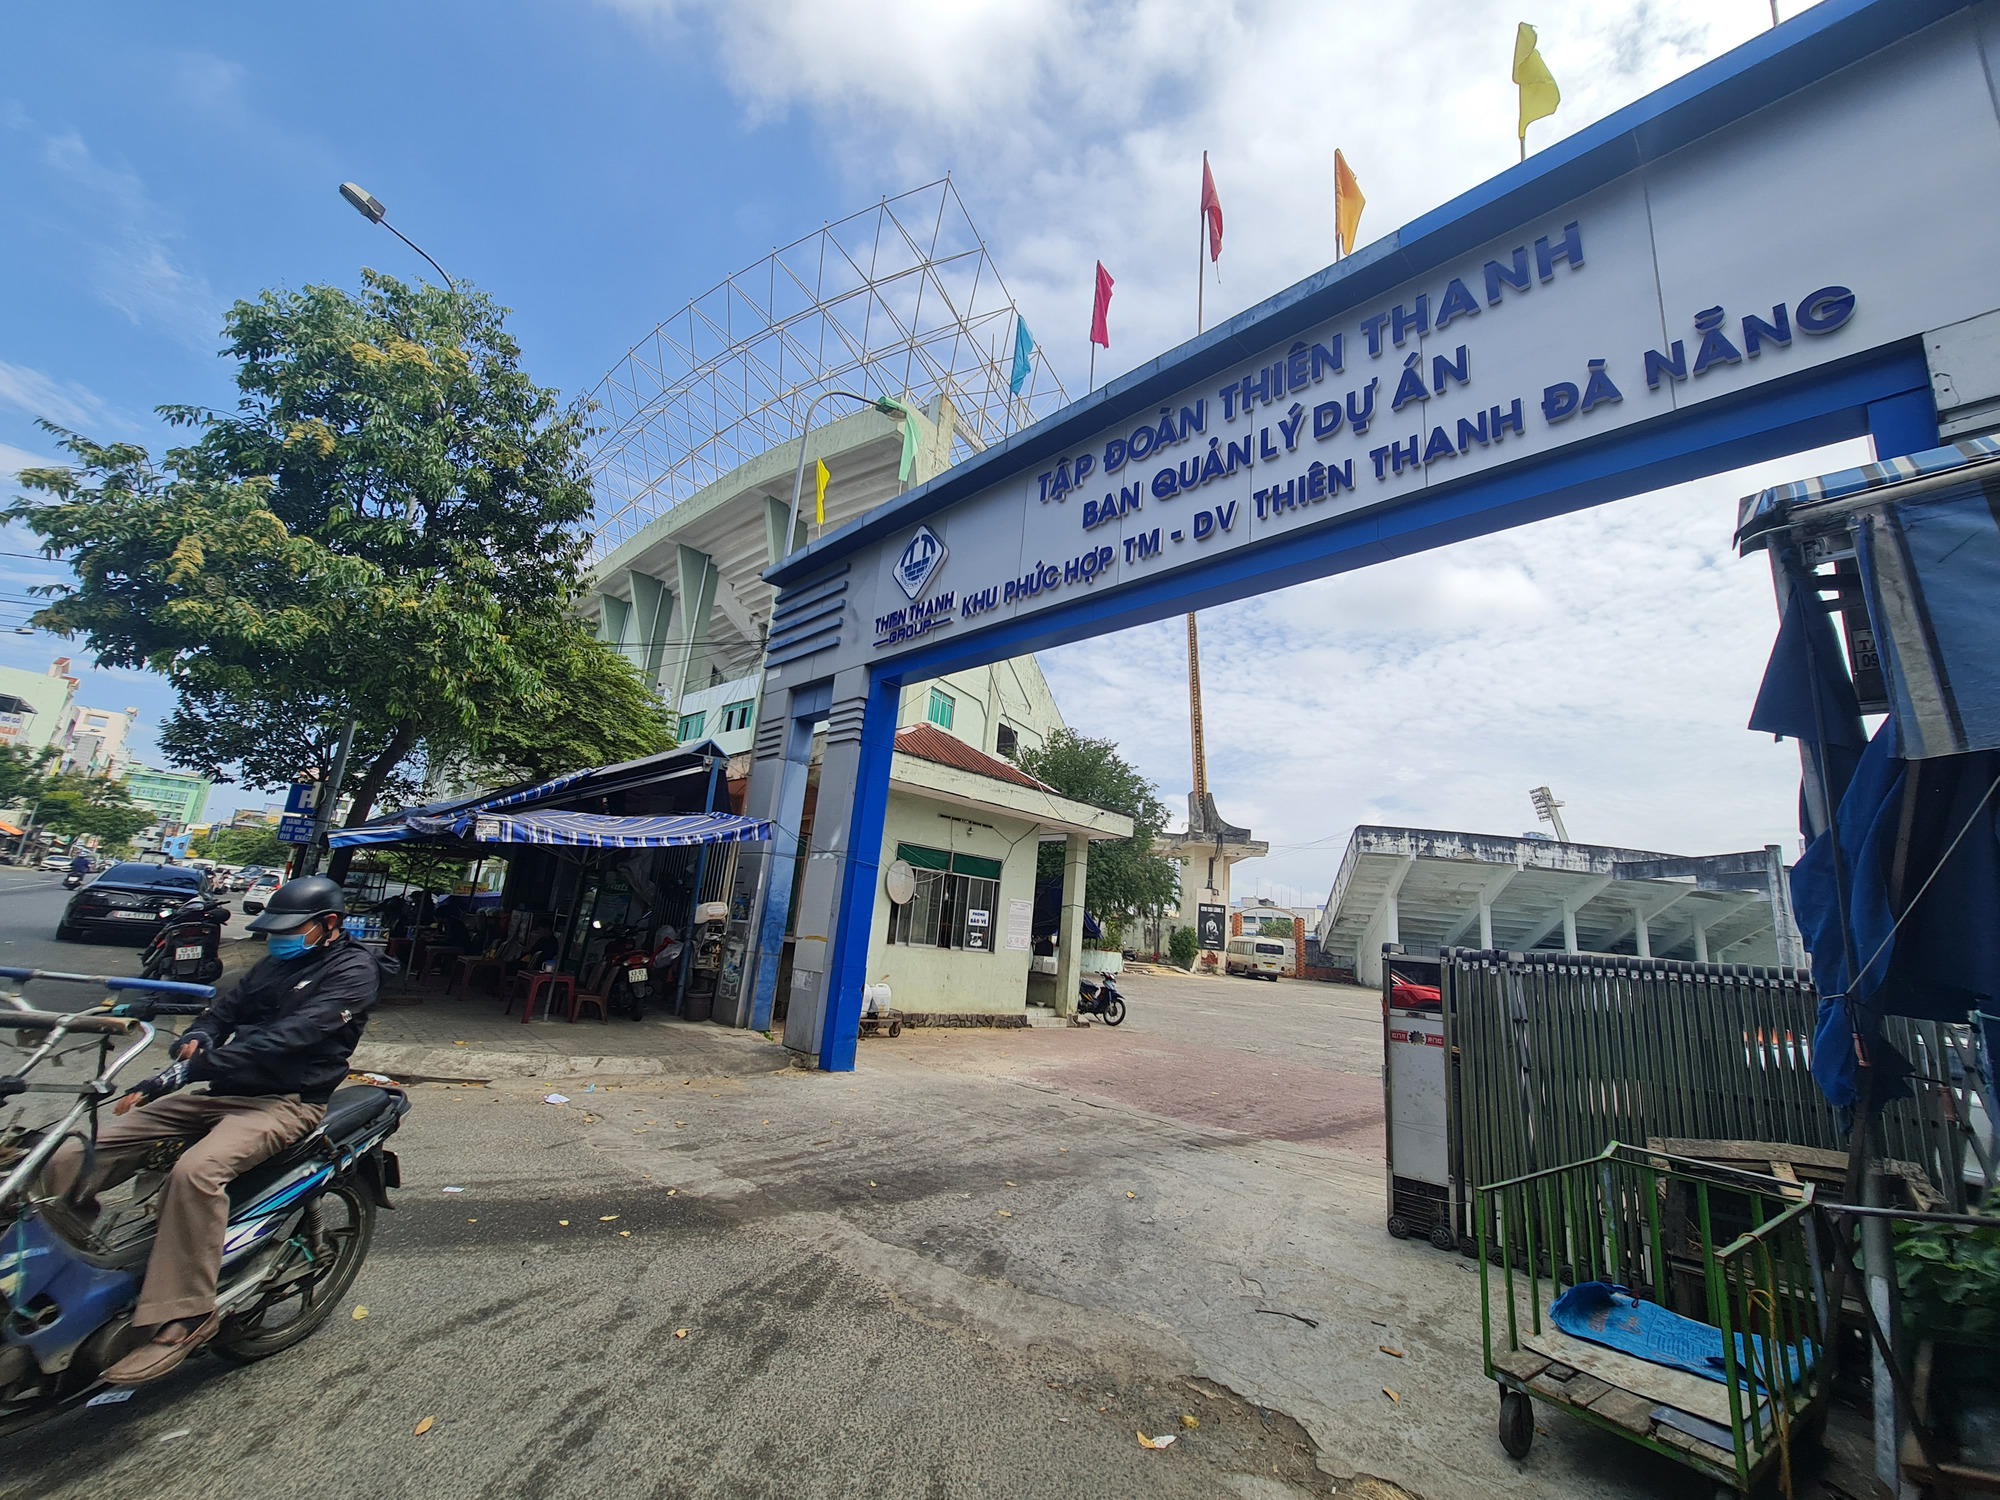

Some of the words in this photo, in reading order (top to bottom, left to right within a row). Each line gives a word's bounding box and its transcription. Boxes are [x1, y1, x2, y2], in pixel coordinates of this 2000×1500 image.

[961, 585, 1001, 619] KHU
[1003, 560, 1062, 605] PHỨC
[1064, 545, 1116, 585] HỢP
[1123, 527, 1165, 565] TM
[1193, 500, 1239, 541] DV
[1253, 458, 1356, 520] THIÊN
[1369, 397, 1526, 480] THANH
[1541, 358, 1624, 425] ĐÀ
[1643, 285, 1857, 390] NẴNG
[1038, 453, 1096, 503] TẬP
[1103, 398, 1208, 475] ĐOÀN
[1219, 332, 1345, 422] THIÊN
[1360, 220, 1585, 358] THANH
[1082, 480, 1143, 531] BAN
[1151, 434, 1255, 501] QUẢN
[1260, 402, 1309, 462] LÝ
[1313, 376, 1381, 441] DỰ
[1391, 344, 1471, 412] ÁN
[888, 619, 934, 645] GROUP
[909, 590, 957, 622] THANH
